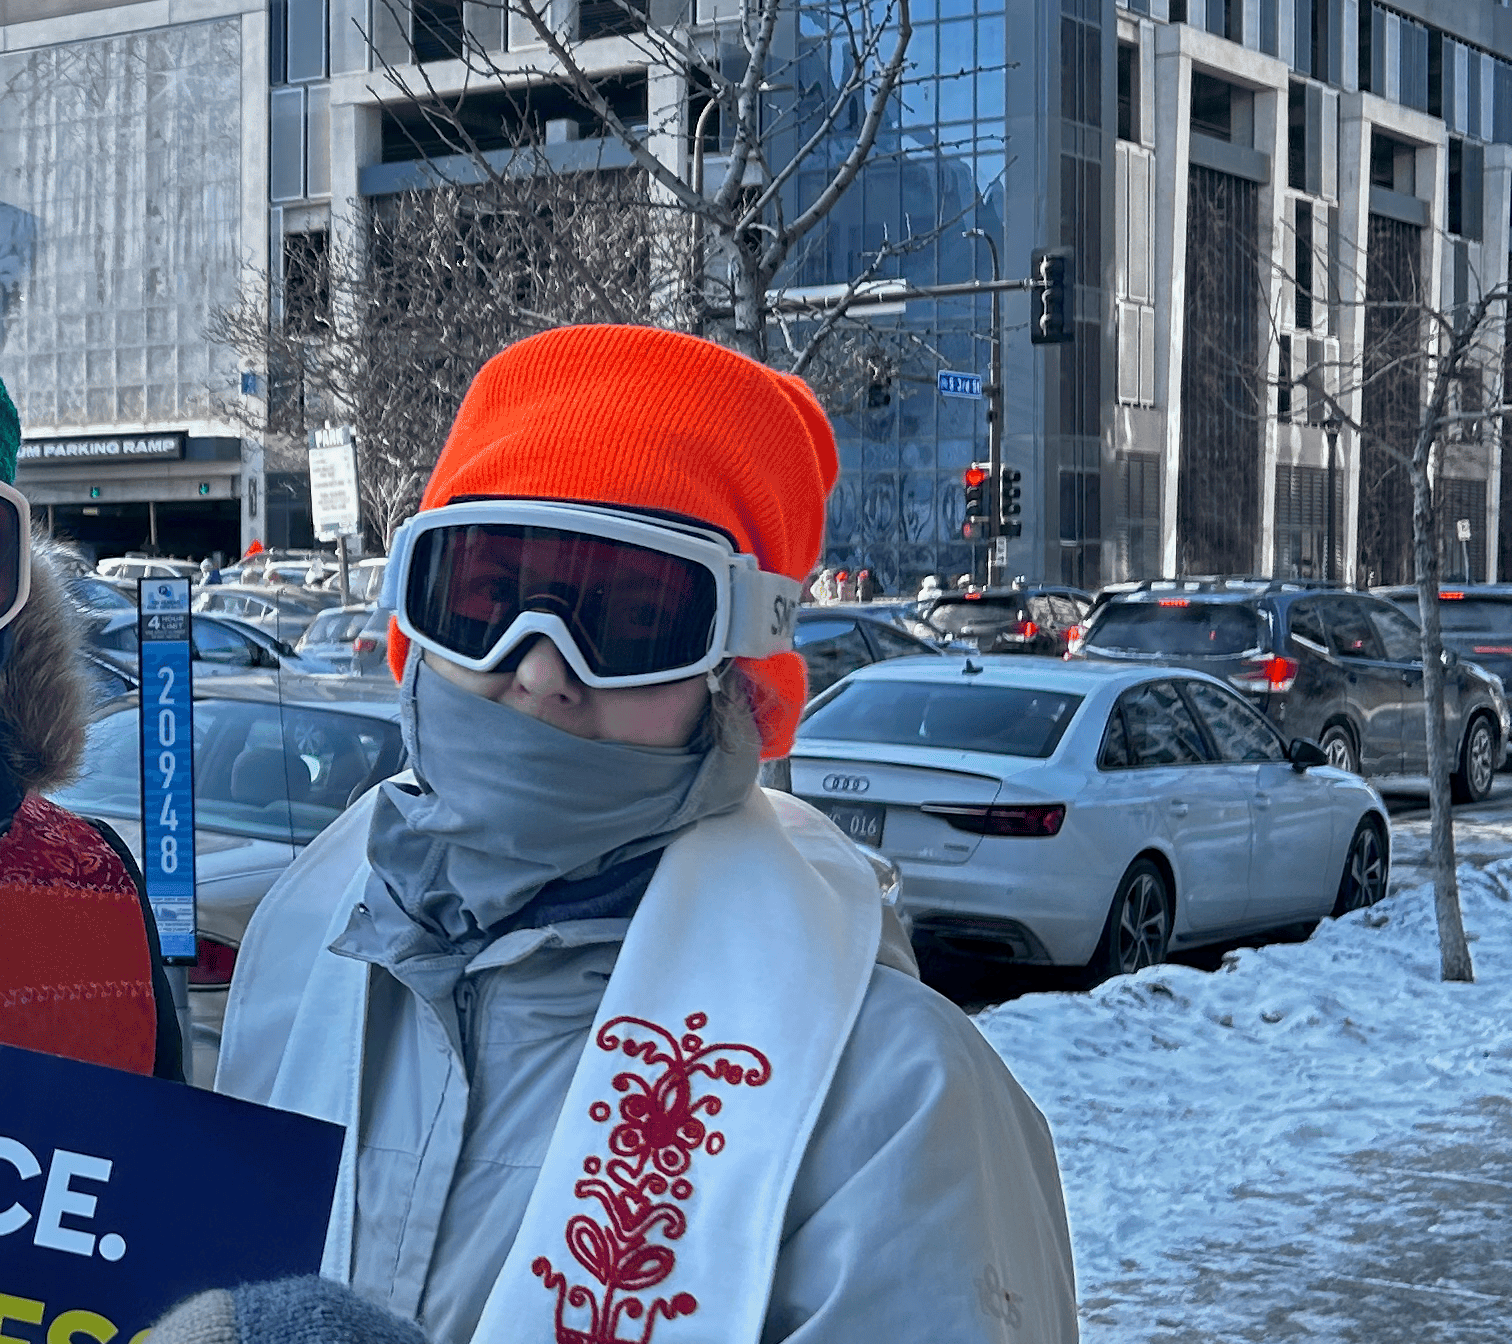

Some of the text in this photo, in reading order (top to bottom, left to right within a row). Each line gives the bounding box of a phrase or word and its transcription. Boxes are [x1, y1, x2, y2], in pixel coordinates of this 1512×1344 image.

[43, 441, 120, 457] PARKING
[122, 438, 175, 454] RAMP
[148, 615, 160, 630] 4
[158, 666, 178, 874] 20948
[850, 815, 877, 837] 016
